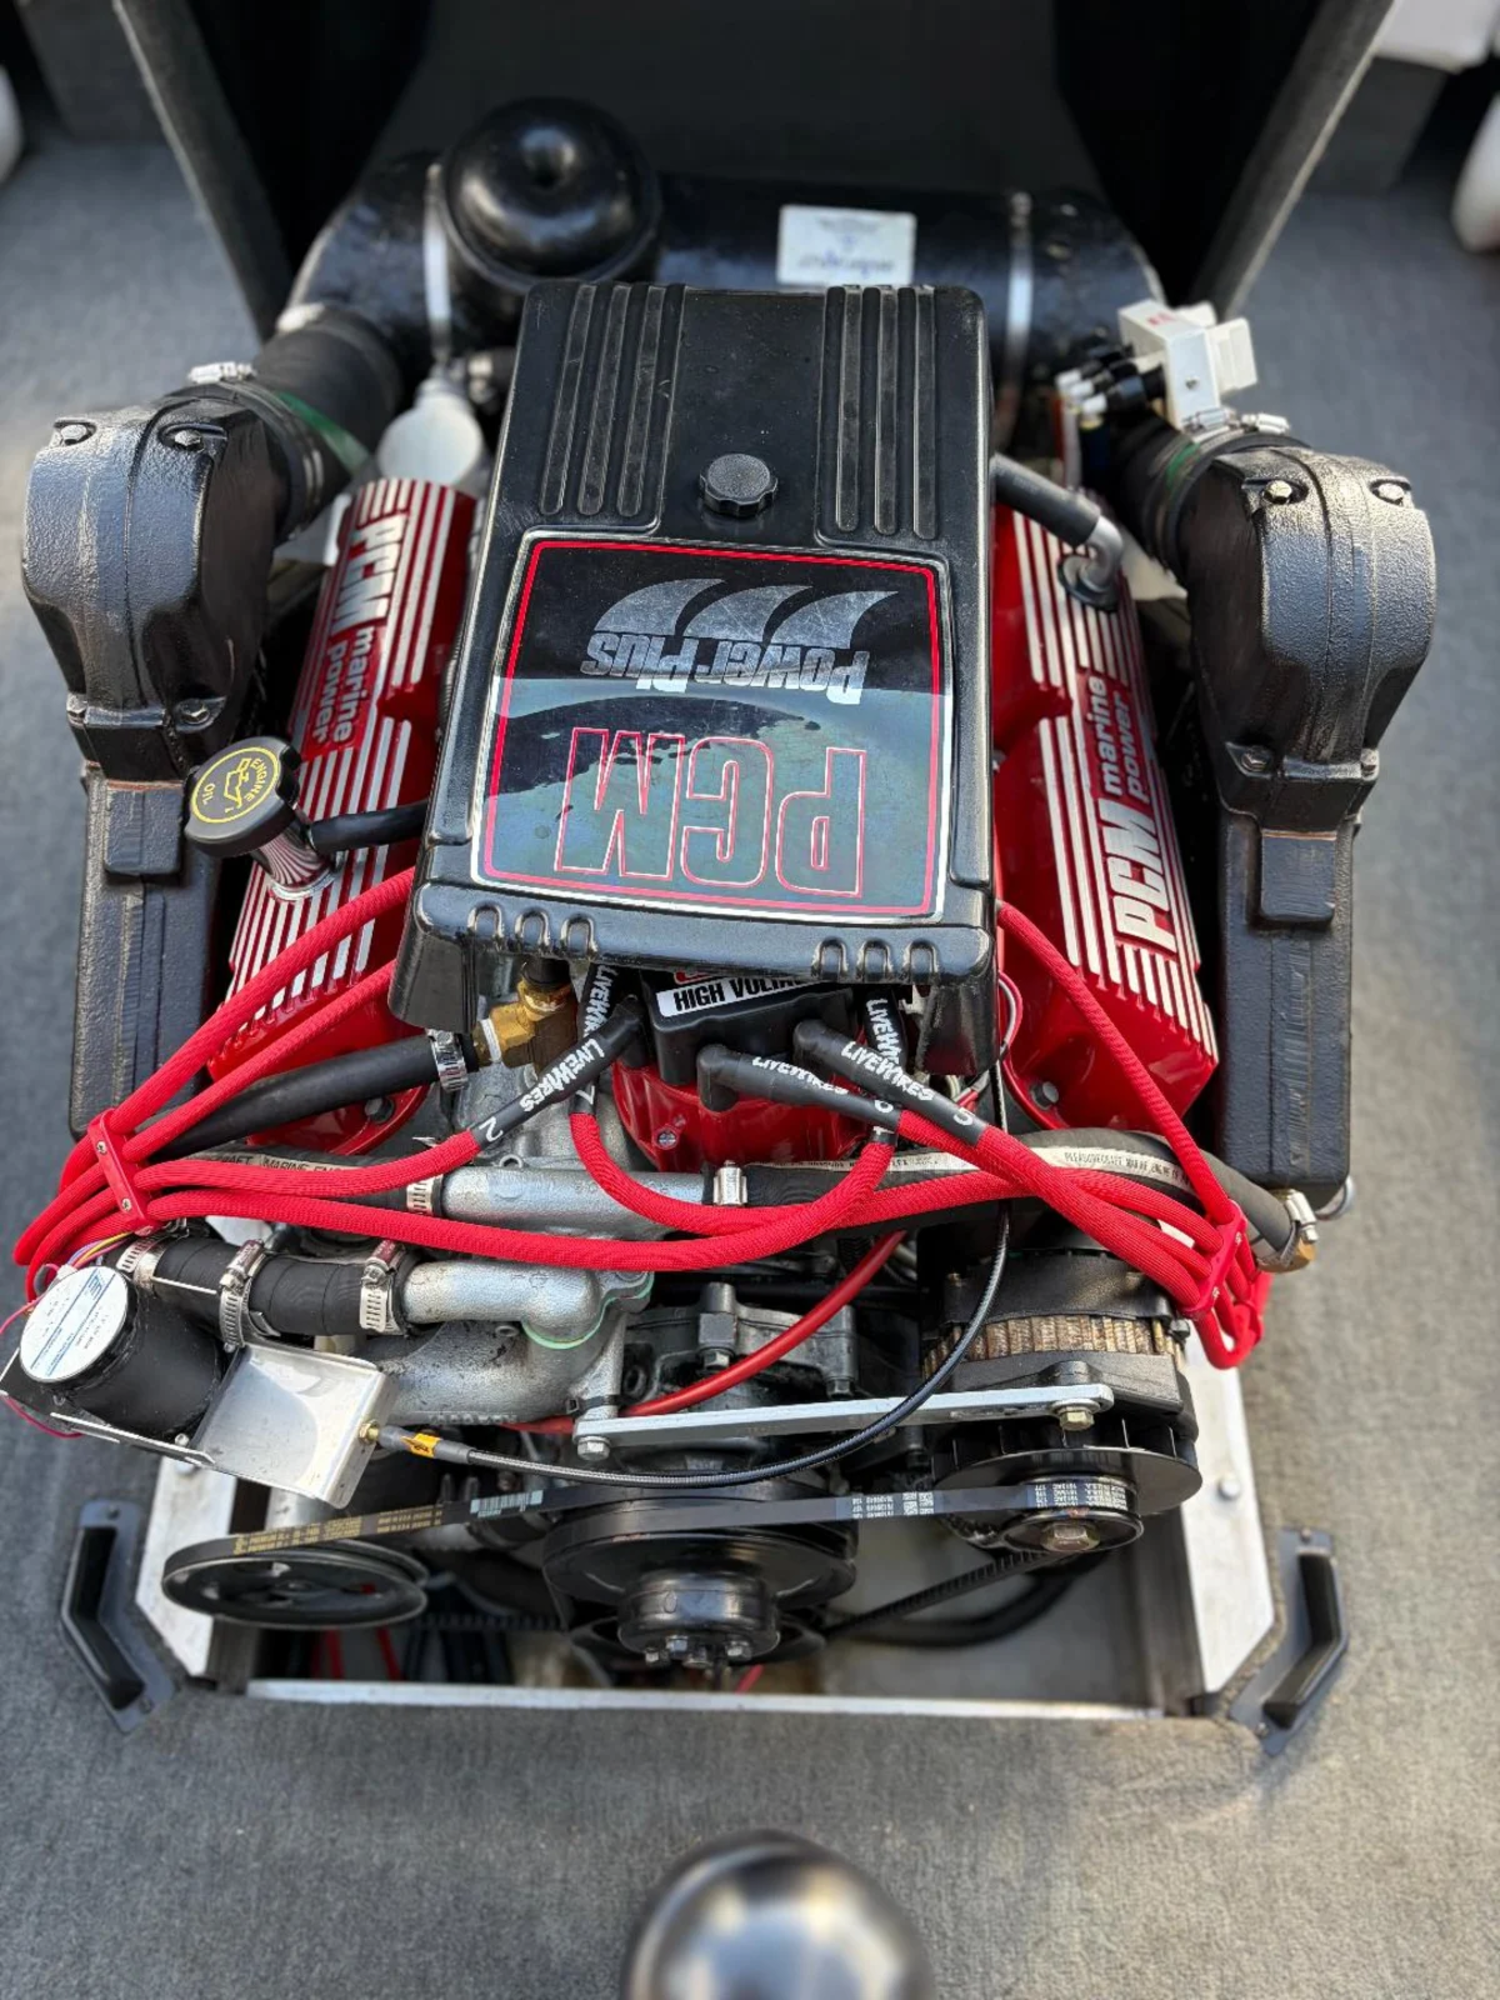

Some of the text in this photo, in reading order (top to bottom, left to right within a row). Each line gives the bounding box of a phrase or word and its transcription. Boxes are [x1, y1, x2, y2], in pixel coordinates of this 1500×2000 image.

[330, 513, 409, 636] PCM
[312, 640, 347, 743] power
[333, 625, 375, 743] marine
[245, 758, 267, 801] ENGINE
[1087, 676, 1124, 797] marine
[1114, 691, 1149, 804] power
[202, 783, 215, 805] OIL
[554, 728, 867, 897] PCM
[1098, 798, 1177, 953] PCM
[673, 982, 725, 1011] HIGH
[520, 1038, 605, 1112] LIVEWIRES
[841, 1041, 936, 1101] LIVEWIRES
[479, 1116, 504, 1142] 2
[953, 1107, 975, 1126] 5
